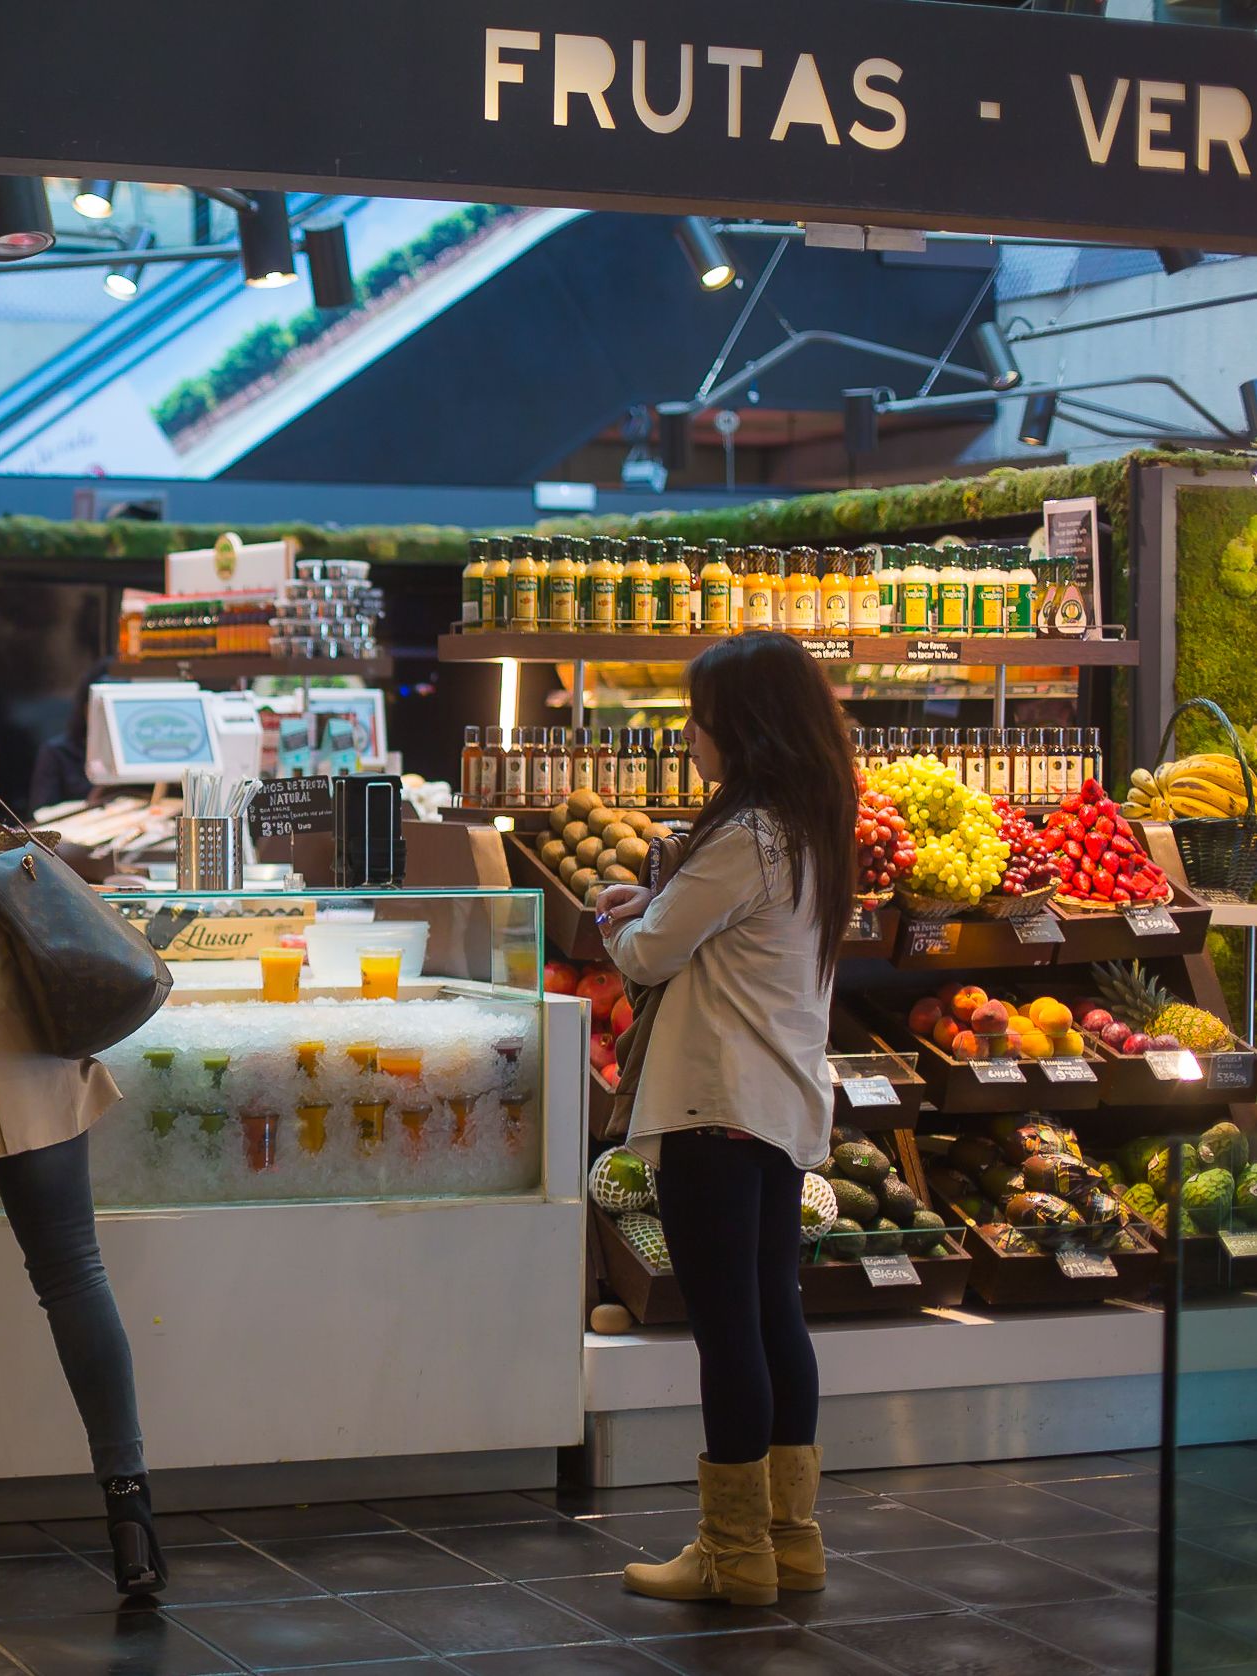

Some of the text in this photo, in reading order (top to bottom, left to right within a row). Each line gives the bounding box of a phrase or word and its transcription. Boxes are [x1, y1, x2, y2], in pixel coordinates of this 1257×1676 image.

[484, 27, 1253, 180] FRUTAS VER
[826, 640, 836, 649] do
[836, 640, 849, 649] not
[917, 641, 949, 651] Por favor,
[908, 651, 917, 659] no
[917, 650, 935, 659] tocar
[934, 650, 942, 659] la
[269, 791, 312, 807] NATURAL
[172, 923, 254, 952] Llusar
